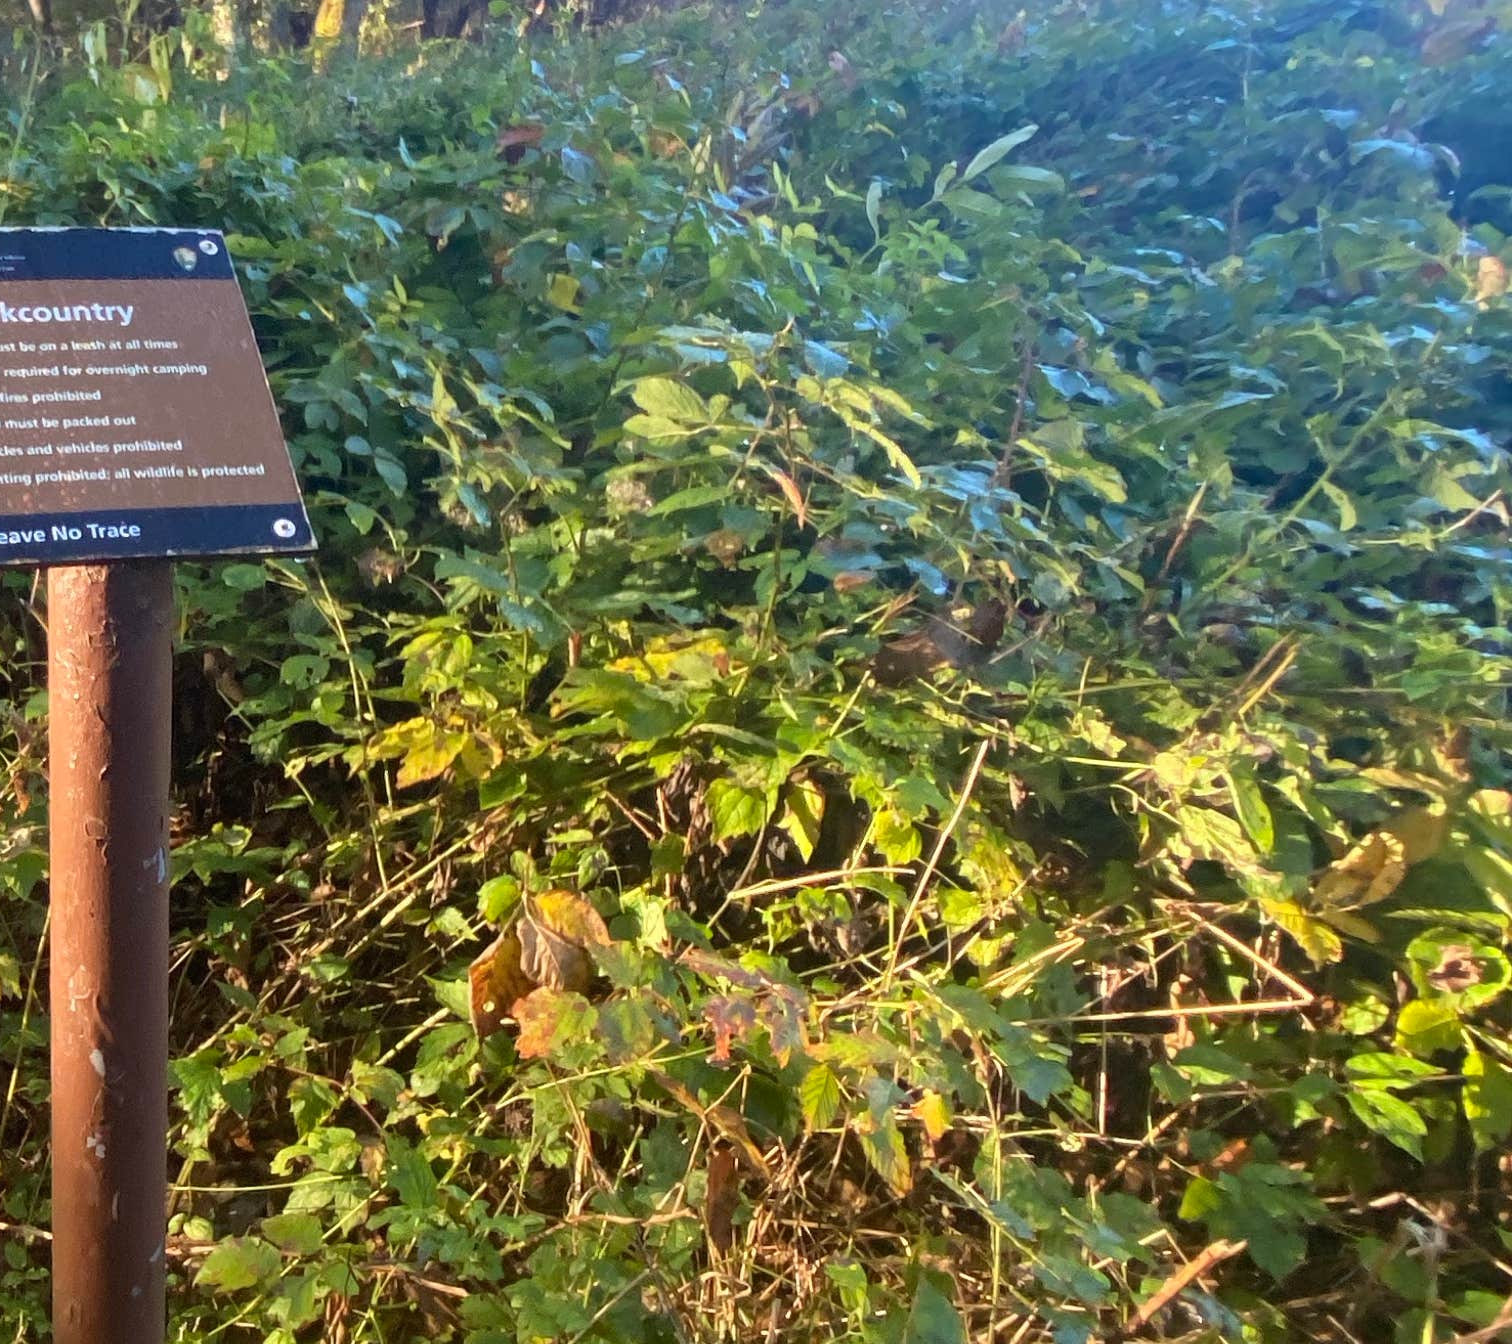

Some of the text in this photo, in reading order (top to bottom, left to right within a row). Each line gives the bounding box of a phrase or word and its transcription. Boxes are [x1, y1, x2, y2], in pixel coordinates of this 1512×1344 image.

[19, 341, 36, 352] be
[39, 342, 57, 351] on
[60, 342, 69, 351] a
[71, 340, 106, 350] leash
[108, 341, 122, 350] at
[125, 339, 141, 350] all
[144, 339, 179, 349] times
[3, 365, 60, 378] required
[62, 365, 82, 376] for
[85, 364, 149, 376] overnight
[152, 363, 208, 376] camping
[32, 389, 102, 404] prohibited
[4, 418, 39, 429] must
[41, 416, 59, 428] be
[62, 415, 110, 429] packed
[113, 415, 137, 426] out
[26, 443, 53, 456] and
[56, 441, 110, 454] vehicles
[113, 439, 183, 454] prohibited
[114, 467, 131, 479] all
[133, 464, 184, 479] wildlife
[186, 465, 199, 477] is
[201, 463, 265, 479] protected
[51, 525, 82, 542] No
[86, 523, 141, 539] Trace
